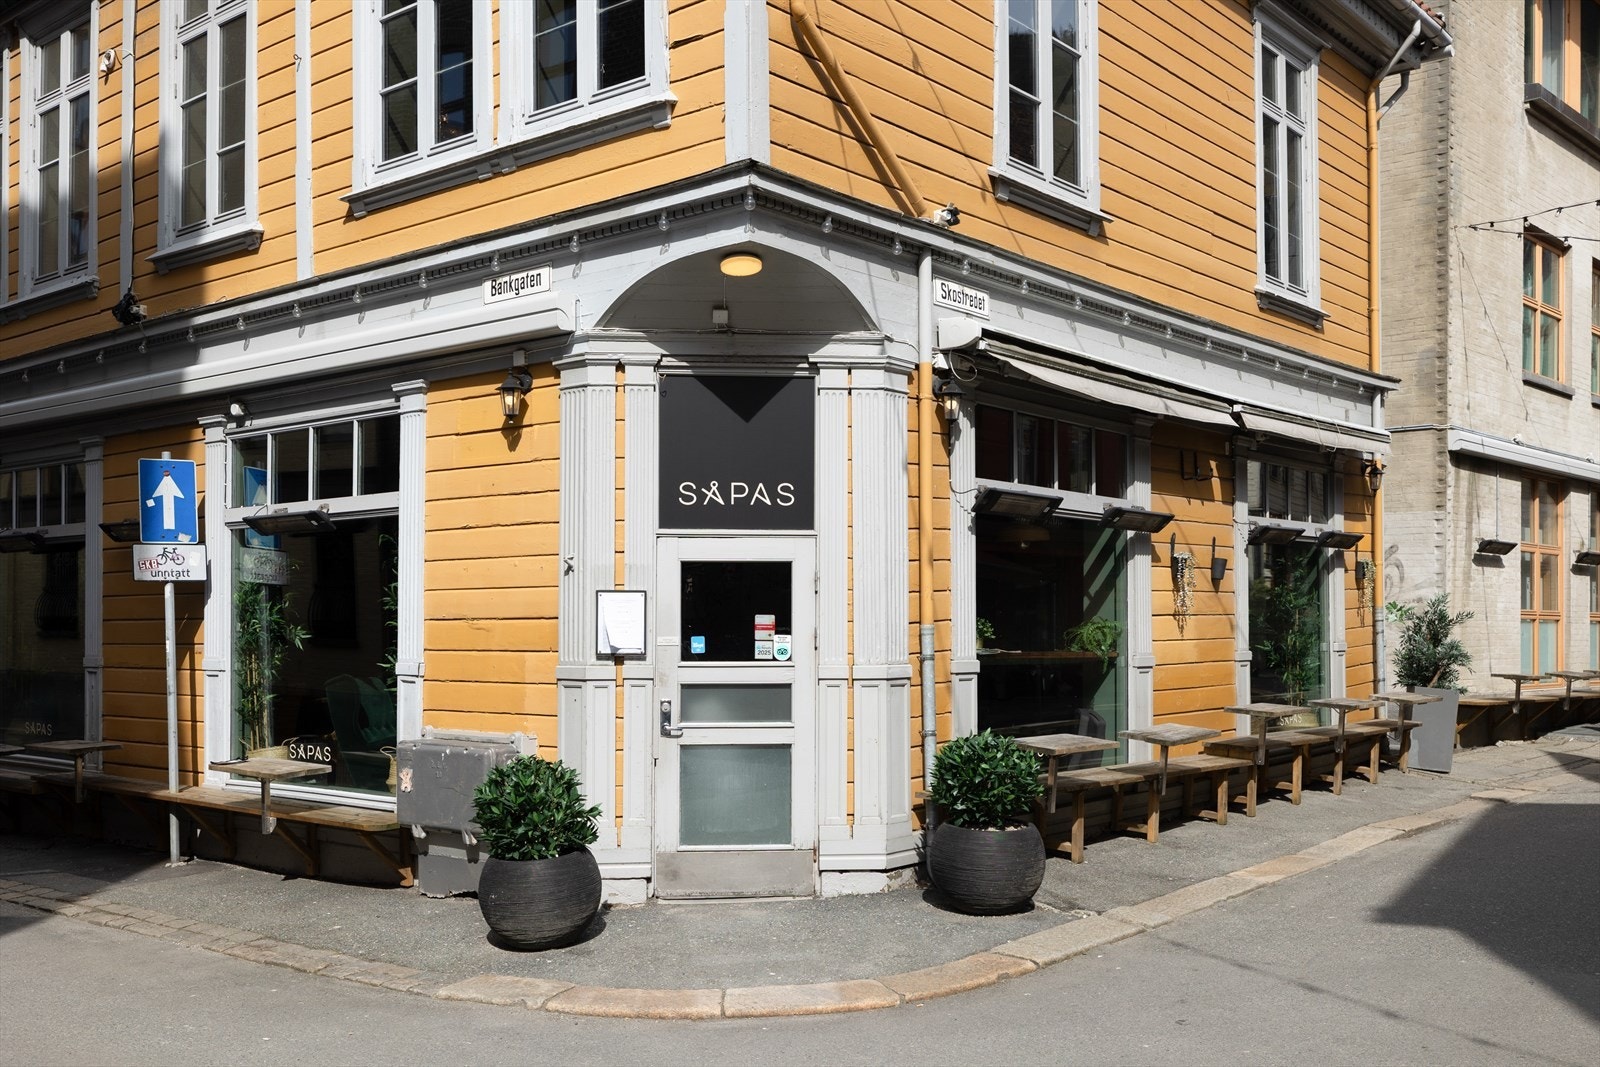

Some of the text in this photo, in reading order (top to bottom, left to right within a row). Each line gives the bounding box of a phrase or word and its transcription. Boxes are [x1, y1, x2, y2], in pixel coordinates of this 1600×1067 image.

[491, 273, 542, 296] Bankgaten
[941, 282, 985, 311] Skostredet
[151, 569, 191, 578] unntatt
